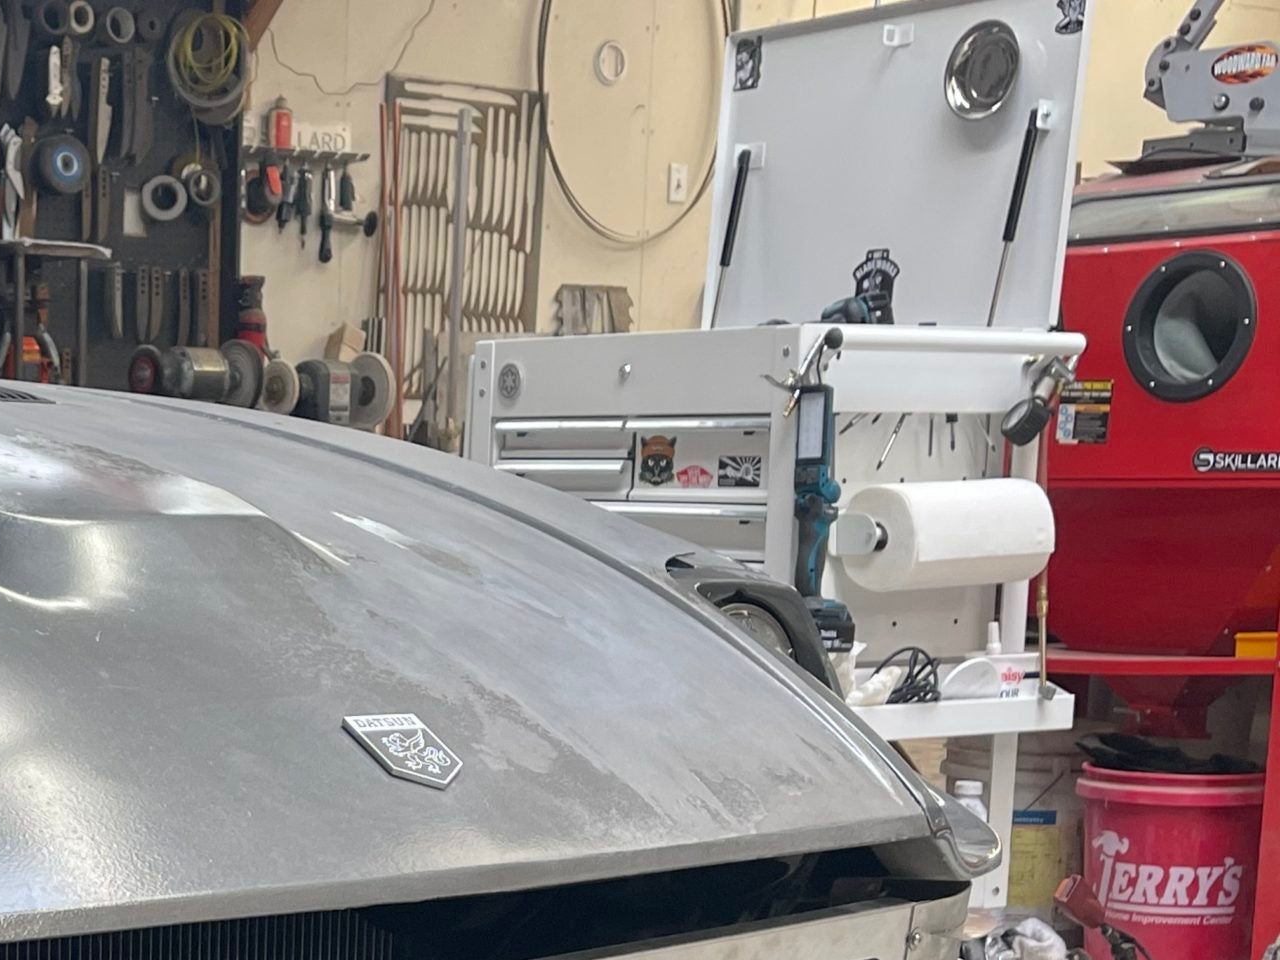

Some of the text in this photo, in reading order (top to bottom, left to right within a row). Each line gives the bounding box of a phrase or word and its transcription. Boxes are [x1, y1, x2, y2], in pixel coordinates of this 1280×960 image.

[1215, 452, 1280, 472] SKILLAR
[1001, 666, 1024, 685] aisy
[352, 715, 417, 729] DATSUN
[1092, 831, 1242, 907] JERRY'S
